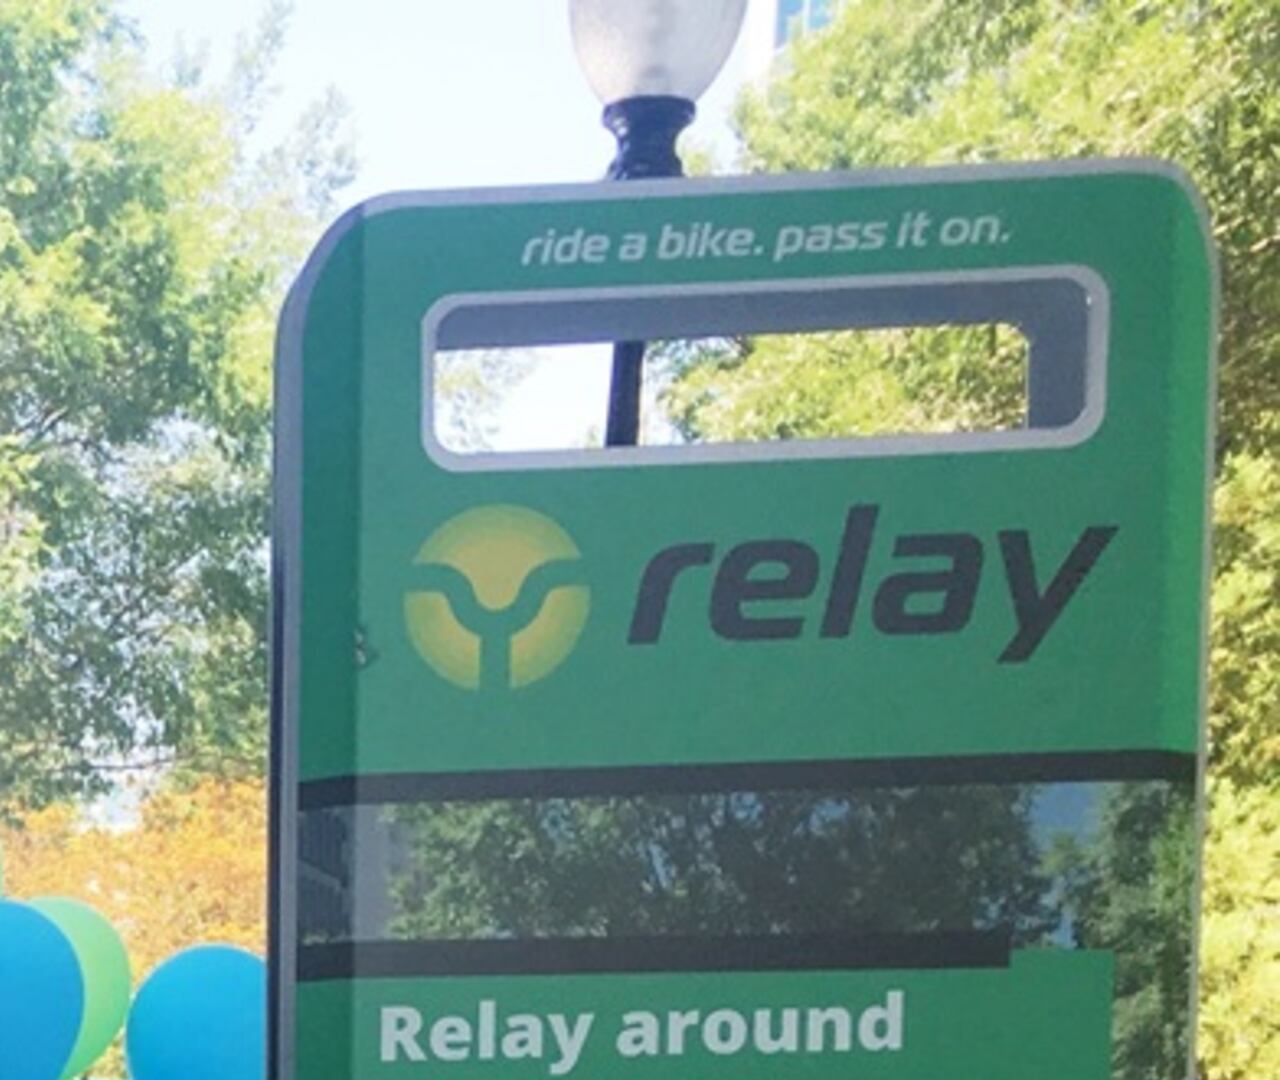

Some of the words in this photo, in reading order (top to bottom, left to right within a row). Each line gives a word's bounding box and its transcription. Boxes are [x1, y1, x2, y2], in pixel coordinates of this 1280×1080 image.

[520, 228, 611, 266] ride
[618, 232, 647, 262] a
[656, 222, 763, 259] bike.
[773, 221, 887, 262] pass
[896, 211, 931, 248] it
[939, 215, 1011, 246] on.
[627, 503, 1120, 665] relay
[380, 1000, 594, 1076] Relay
[616, 990, 904, 1055] around
